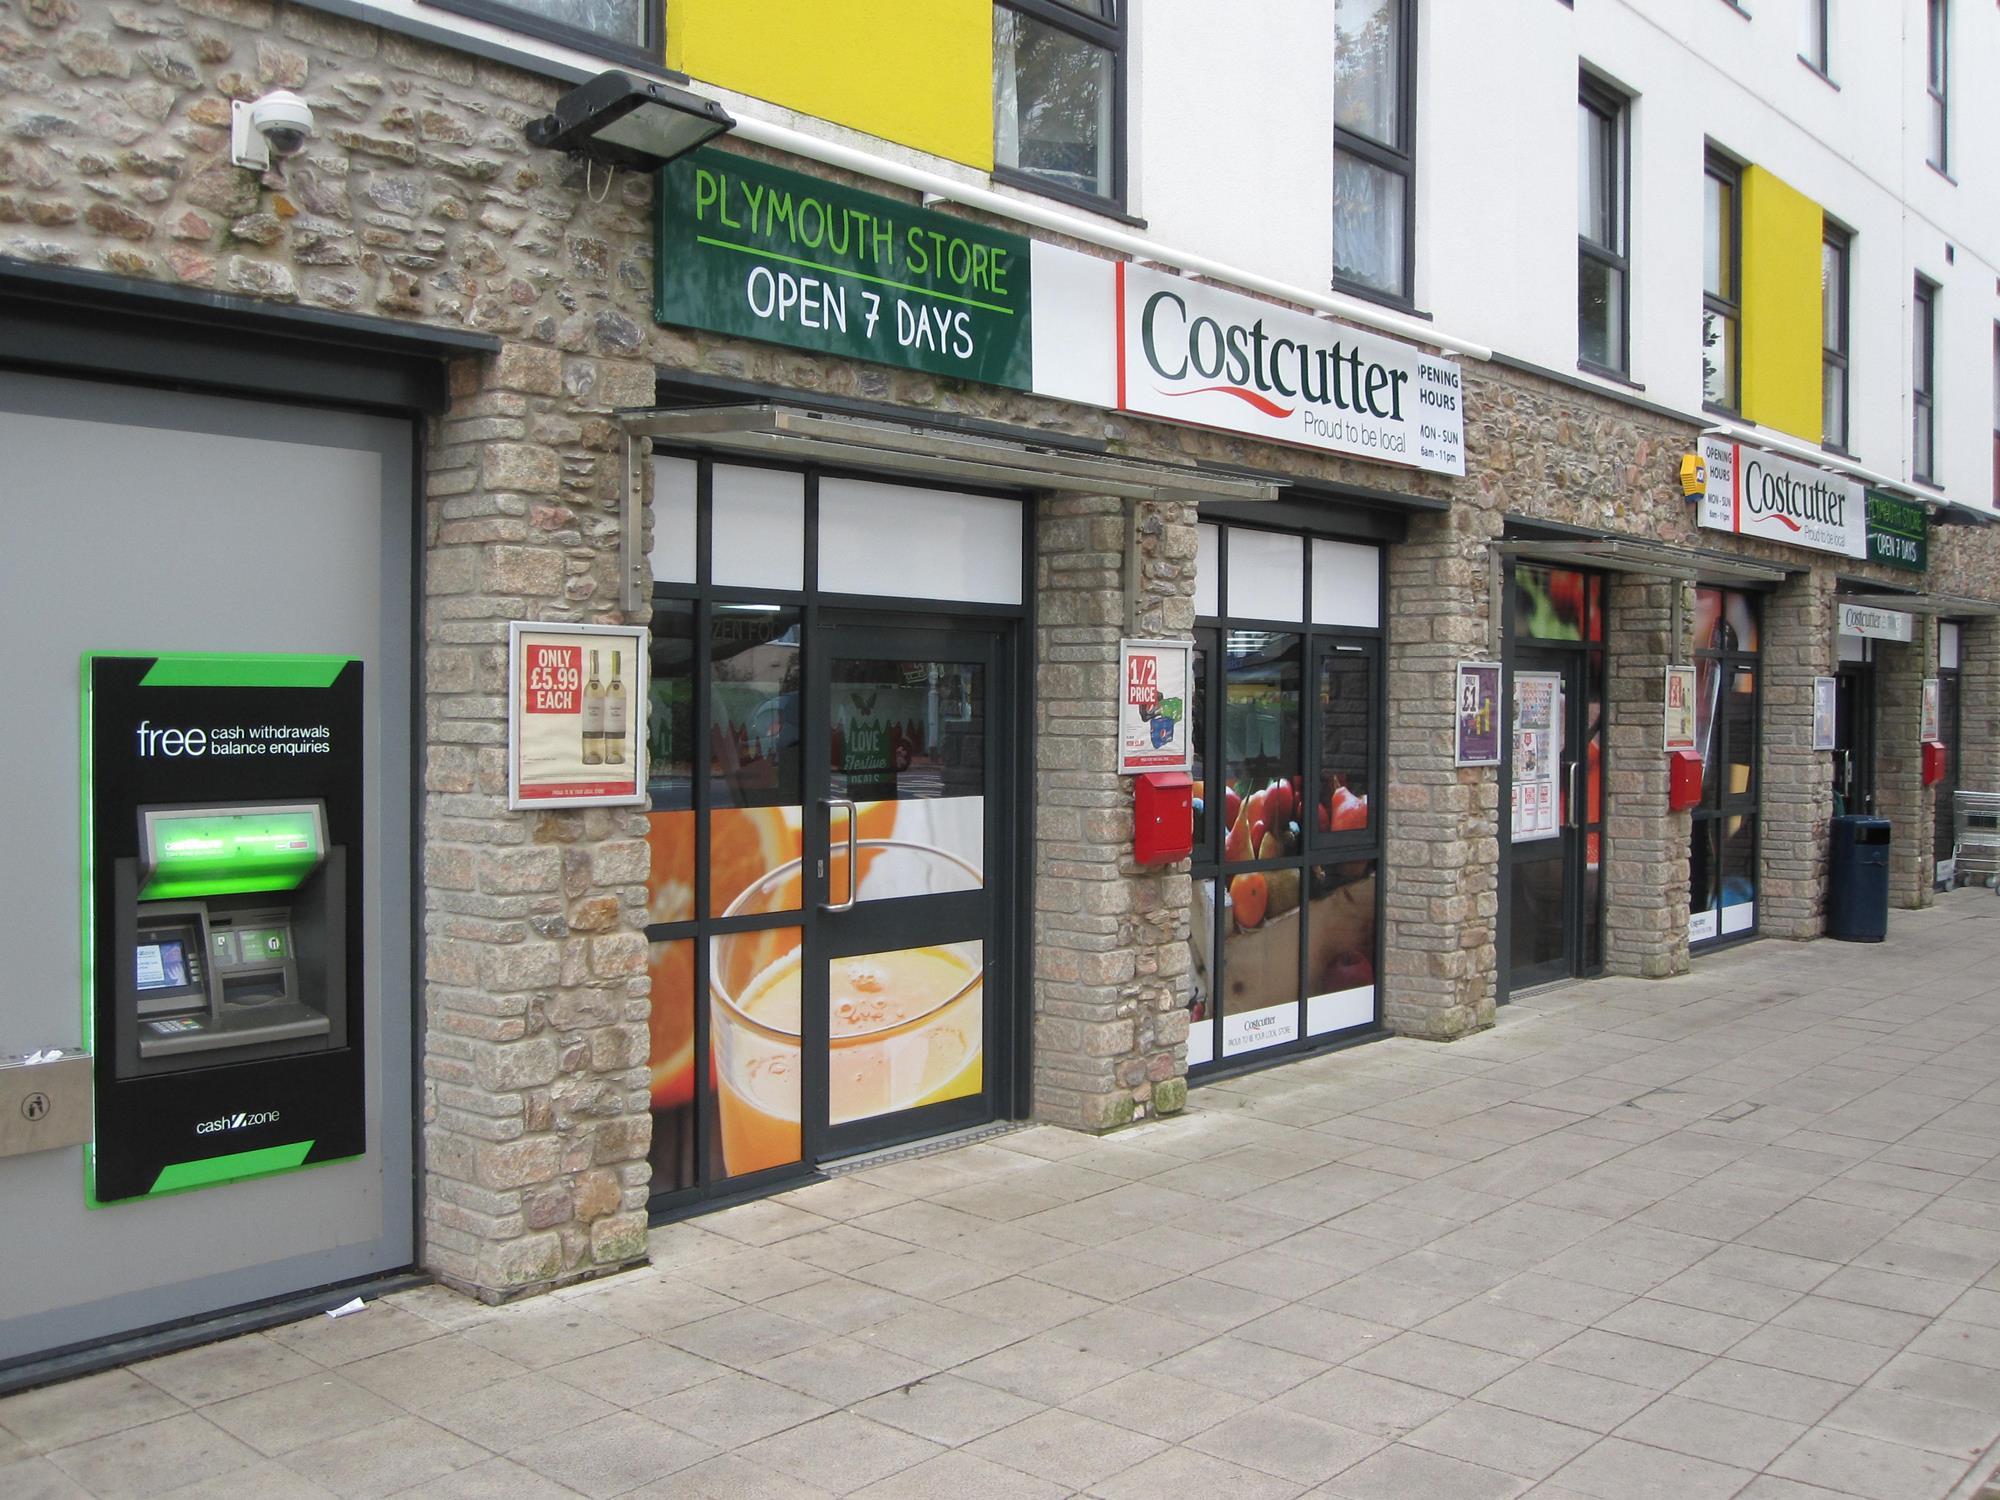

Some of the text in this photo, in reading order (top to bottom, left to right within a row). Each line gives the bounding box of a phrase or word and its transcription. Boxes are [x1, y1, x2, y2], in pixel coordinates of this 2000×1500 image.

[696, 169, 1008, 295] PLYMOUTH STORE
[747, 266, 974, 359] OPEN 7 DAYS
[1141, 290, 1409, 422] Costcutter
[1417, 364, 1459, 389] PENING
[1420, 388, 1456, 411] HOURS
[1304, 410, 1406, 454] Proud to be local
[1442, 430, 1459, 445] SUN
[1439, 449, 1457, 464] 11pm
[1706, 446, 1732, 464] OPENING
[1710, 466, 1730, 482] HOURS
[1745, 461, 1846, 527] Costcutter
[1877, 533, 1895, 556] OPEN
[1901, 540, 1917, 562] DAYS
[538, 649, 572, 668] ONLY
[530, 668, 578, 690] £5.99
[1130, 658, 1156, 685] 1/2
[537, 691, 572, 709] EACH
[1130, 686, 1156, 703] PRICE
[1462, 686, 1477, 712] £1
[136, 720, 330, 756] free cash withdrawals
[211, 740, 330, 757] balance enquiries
[851, 730, 879, 752] LOVE
[845, 755, 888, 770] Festive
